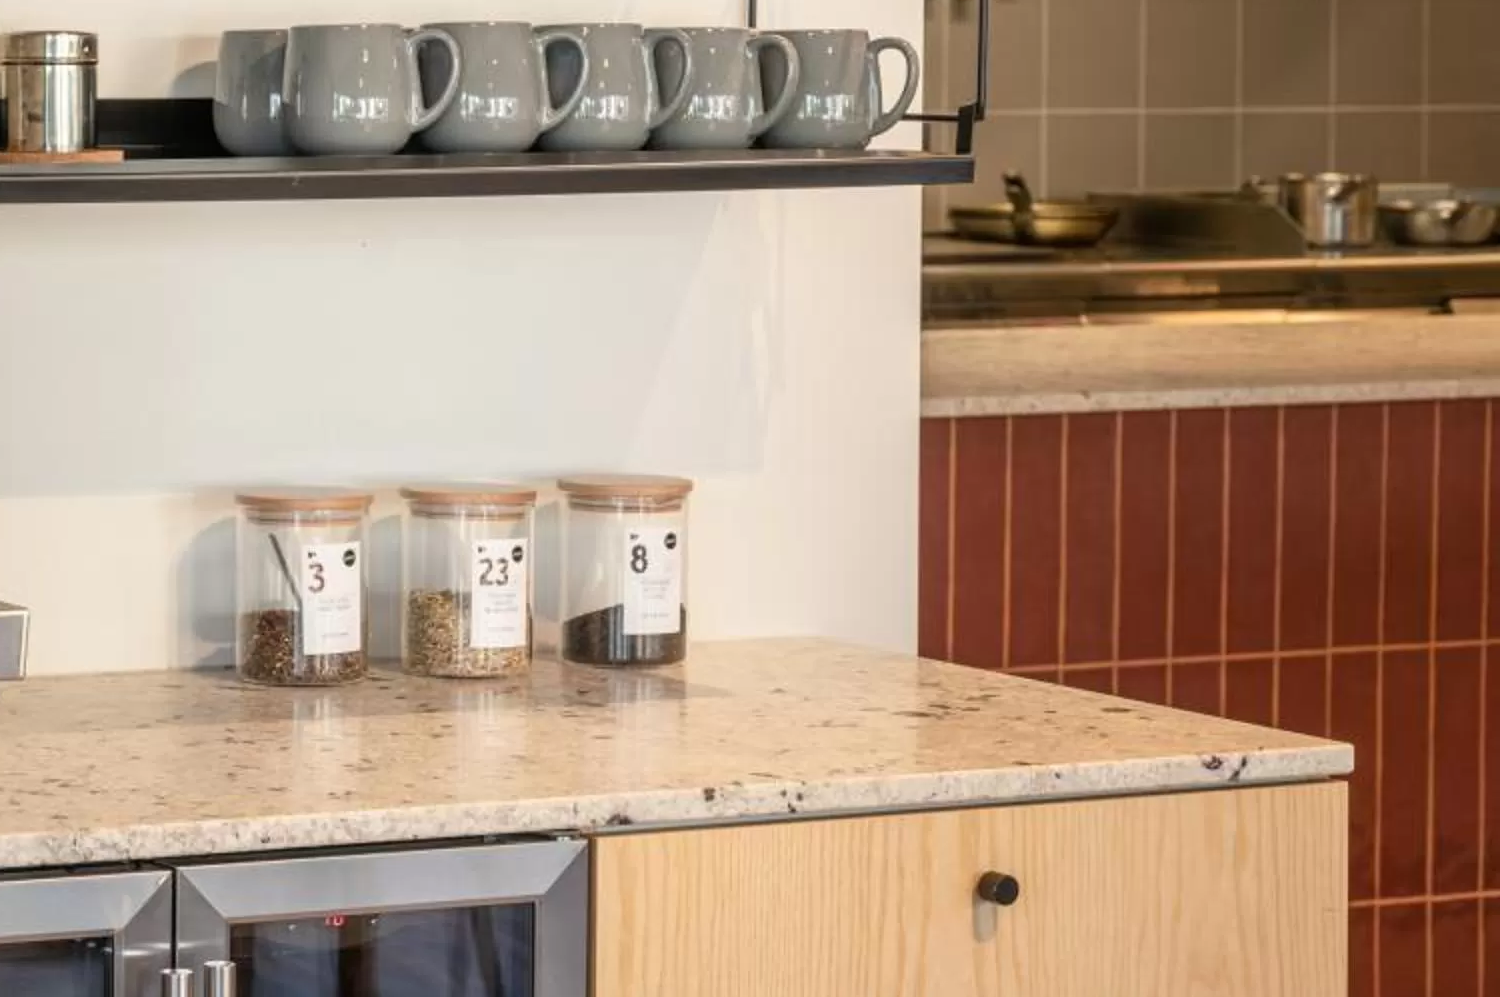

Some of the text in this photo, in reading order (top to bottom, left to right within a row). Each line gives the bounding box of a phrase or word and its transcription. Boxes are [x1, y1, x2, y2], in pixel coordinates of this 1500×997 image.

[478, 557, 509, 587] 23
[630, 544, 648, 574] 8
[307, 562, 325, 593] 3
